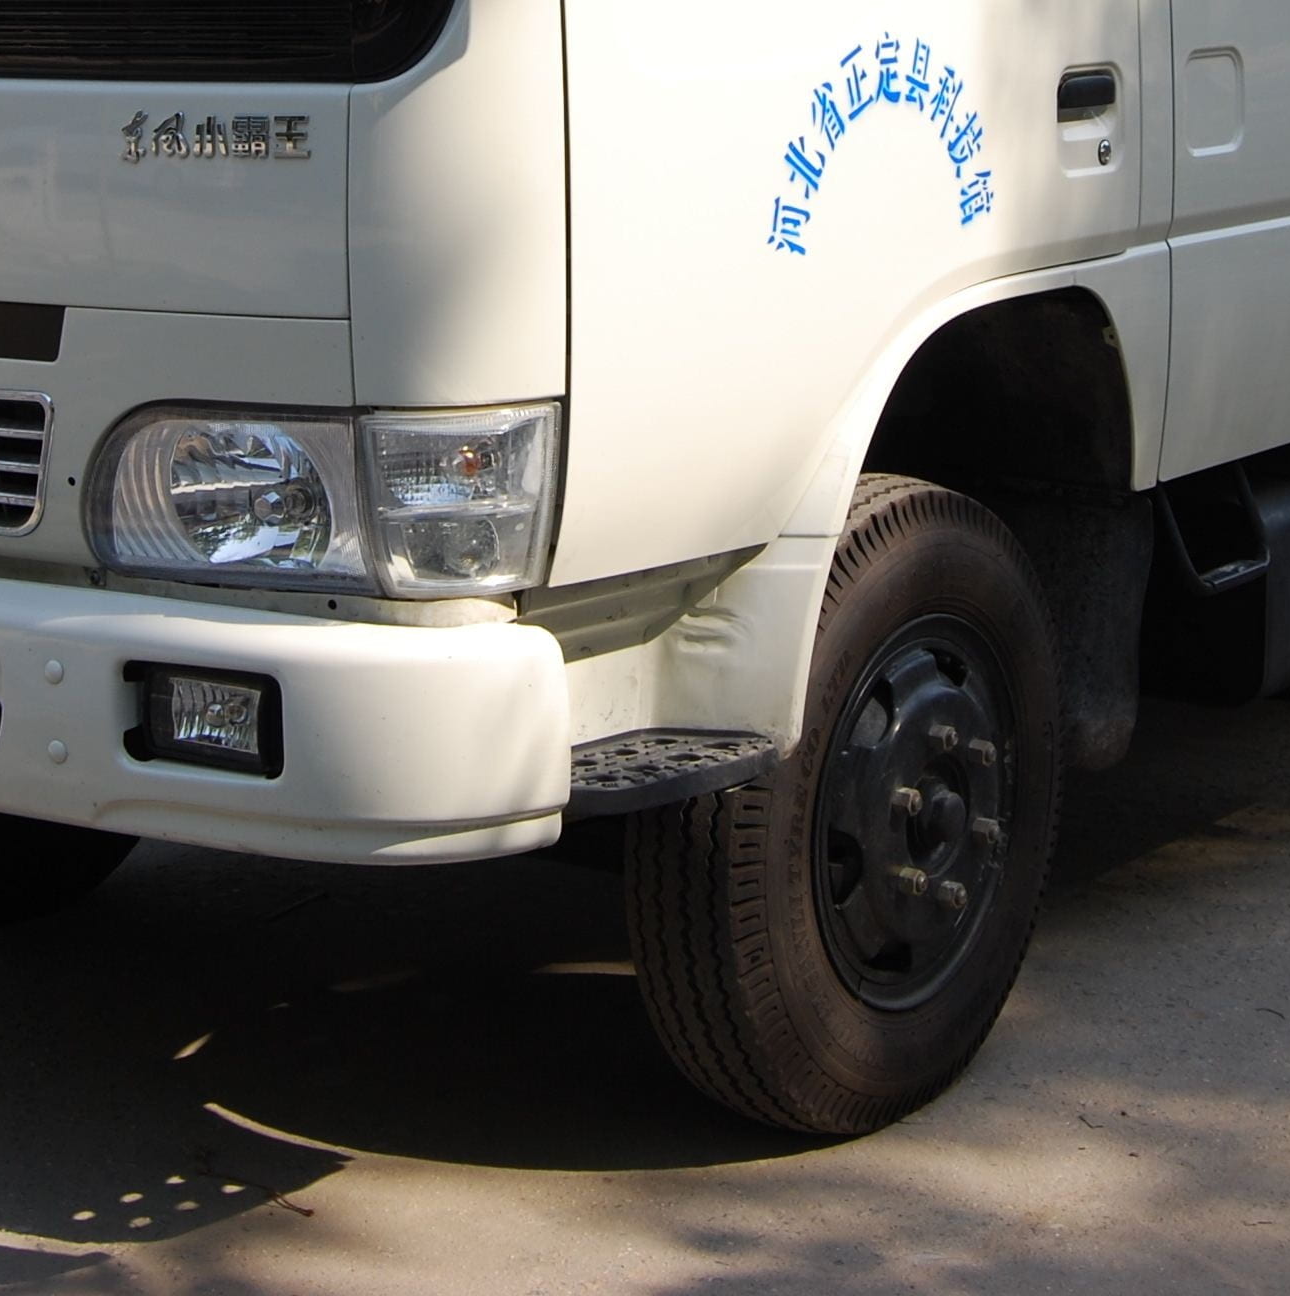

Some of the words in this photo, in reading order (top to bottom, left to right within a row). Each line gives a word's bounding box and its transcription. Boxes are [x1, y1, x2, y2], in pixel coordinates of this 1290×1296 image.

[121, 110, 311, 163] 东风小霸王
[767, 31, 993, 256] 河北省正定县科技馆
